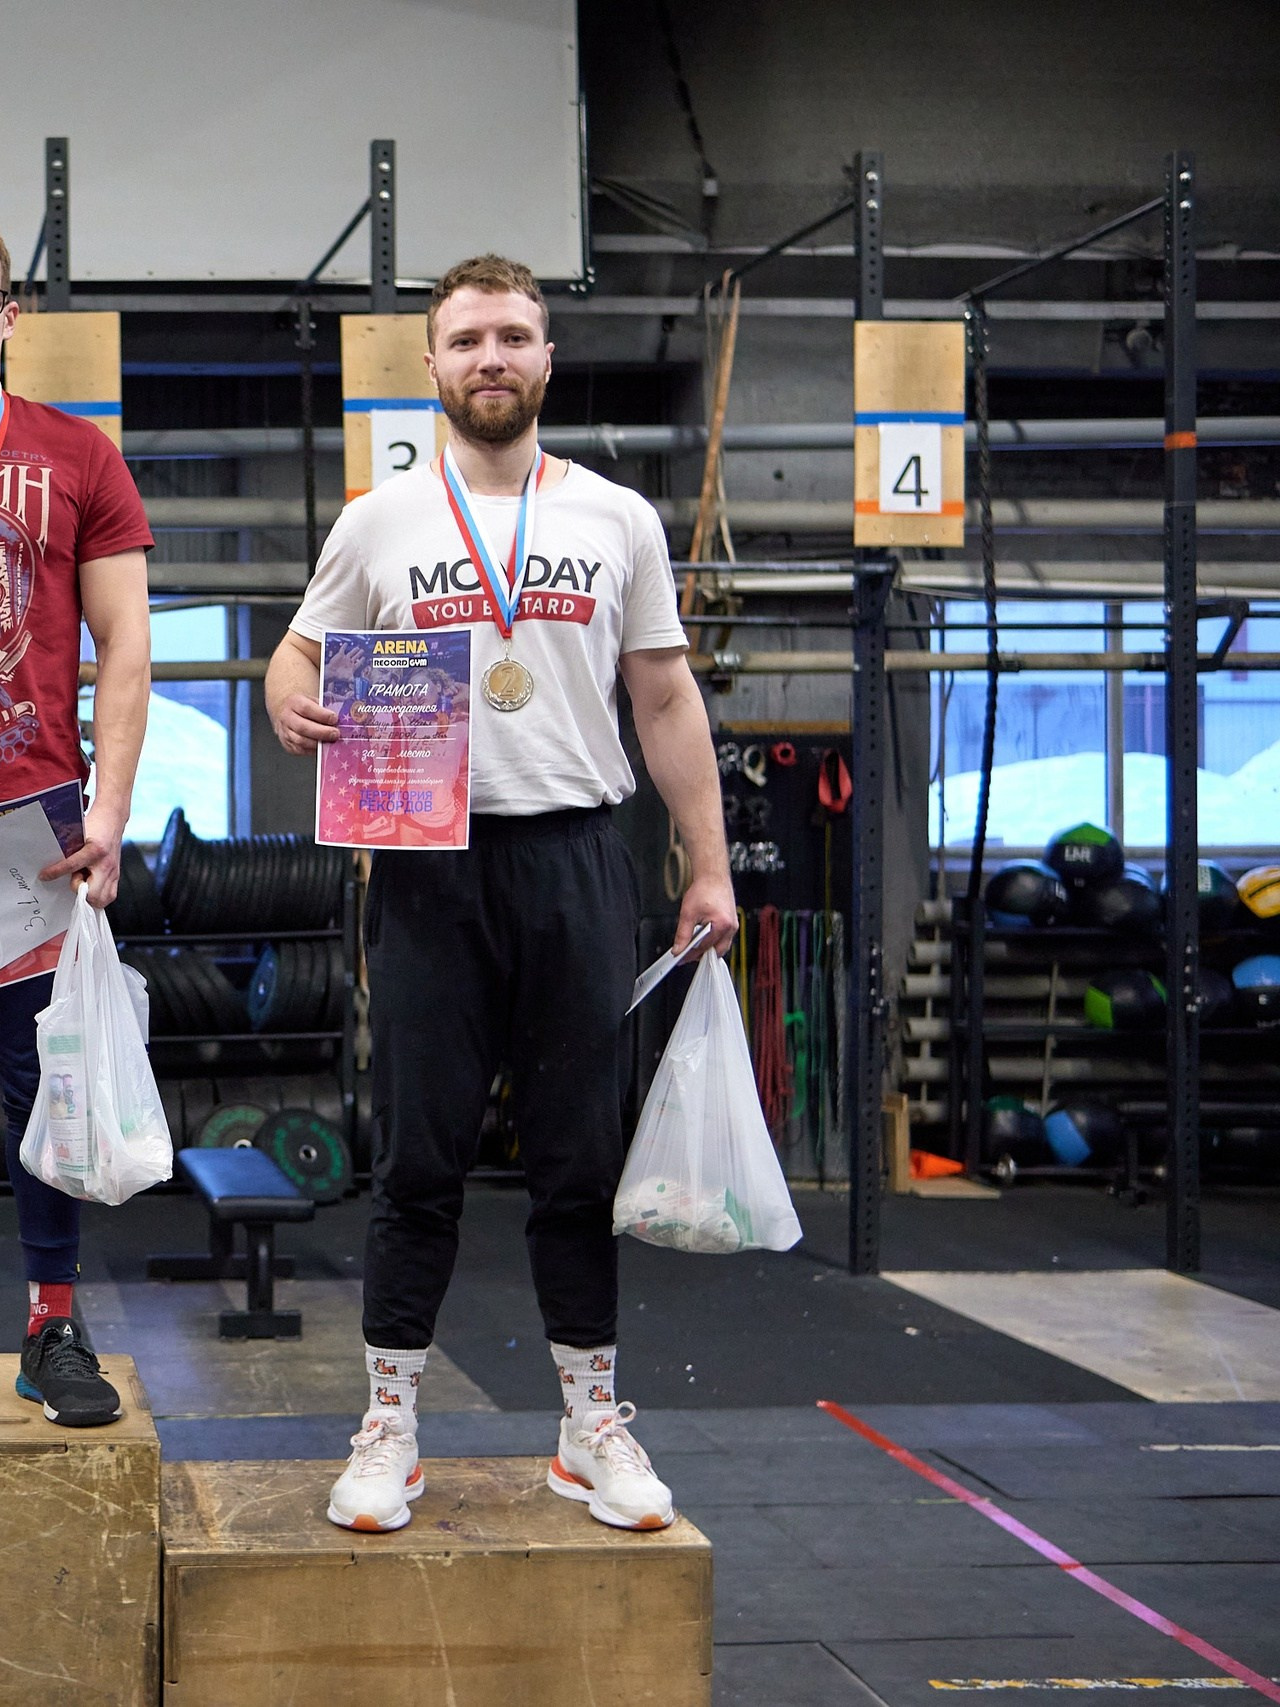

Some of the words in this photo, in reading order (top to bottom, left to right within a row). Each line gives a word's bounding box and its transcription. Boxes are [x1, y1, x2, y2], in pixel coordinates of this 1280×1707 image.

[0, 450, 49, 463] OETRY
[892, 455, 929, 507] 4
[408, 554, 602, 600] MODAY
[427, 599, 473, 622] YOU
[483, 597, 576, 617] BTARD
[372, 640, 429, 654] ARENA
[373, 659, 408, 667] RECORD
[409, 658, 427, 667] GYM
[499, 666, 516, 697] 2
[368, 683, 429, 697] ГРАМОТА
[357, 703, 438, 719] награждается
[361, 749, 375, 761] за
[396, 749, 431, 758] место
[360, 790, 433, 800] ТЕРРИТОРИЯ
[359, 800, 433, 814] РЕКОРДОВ
[9, 867, 31, 891] место
[17, 896, 39, 905] 1
[24, 908, 47, 932] За
